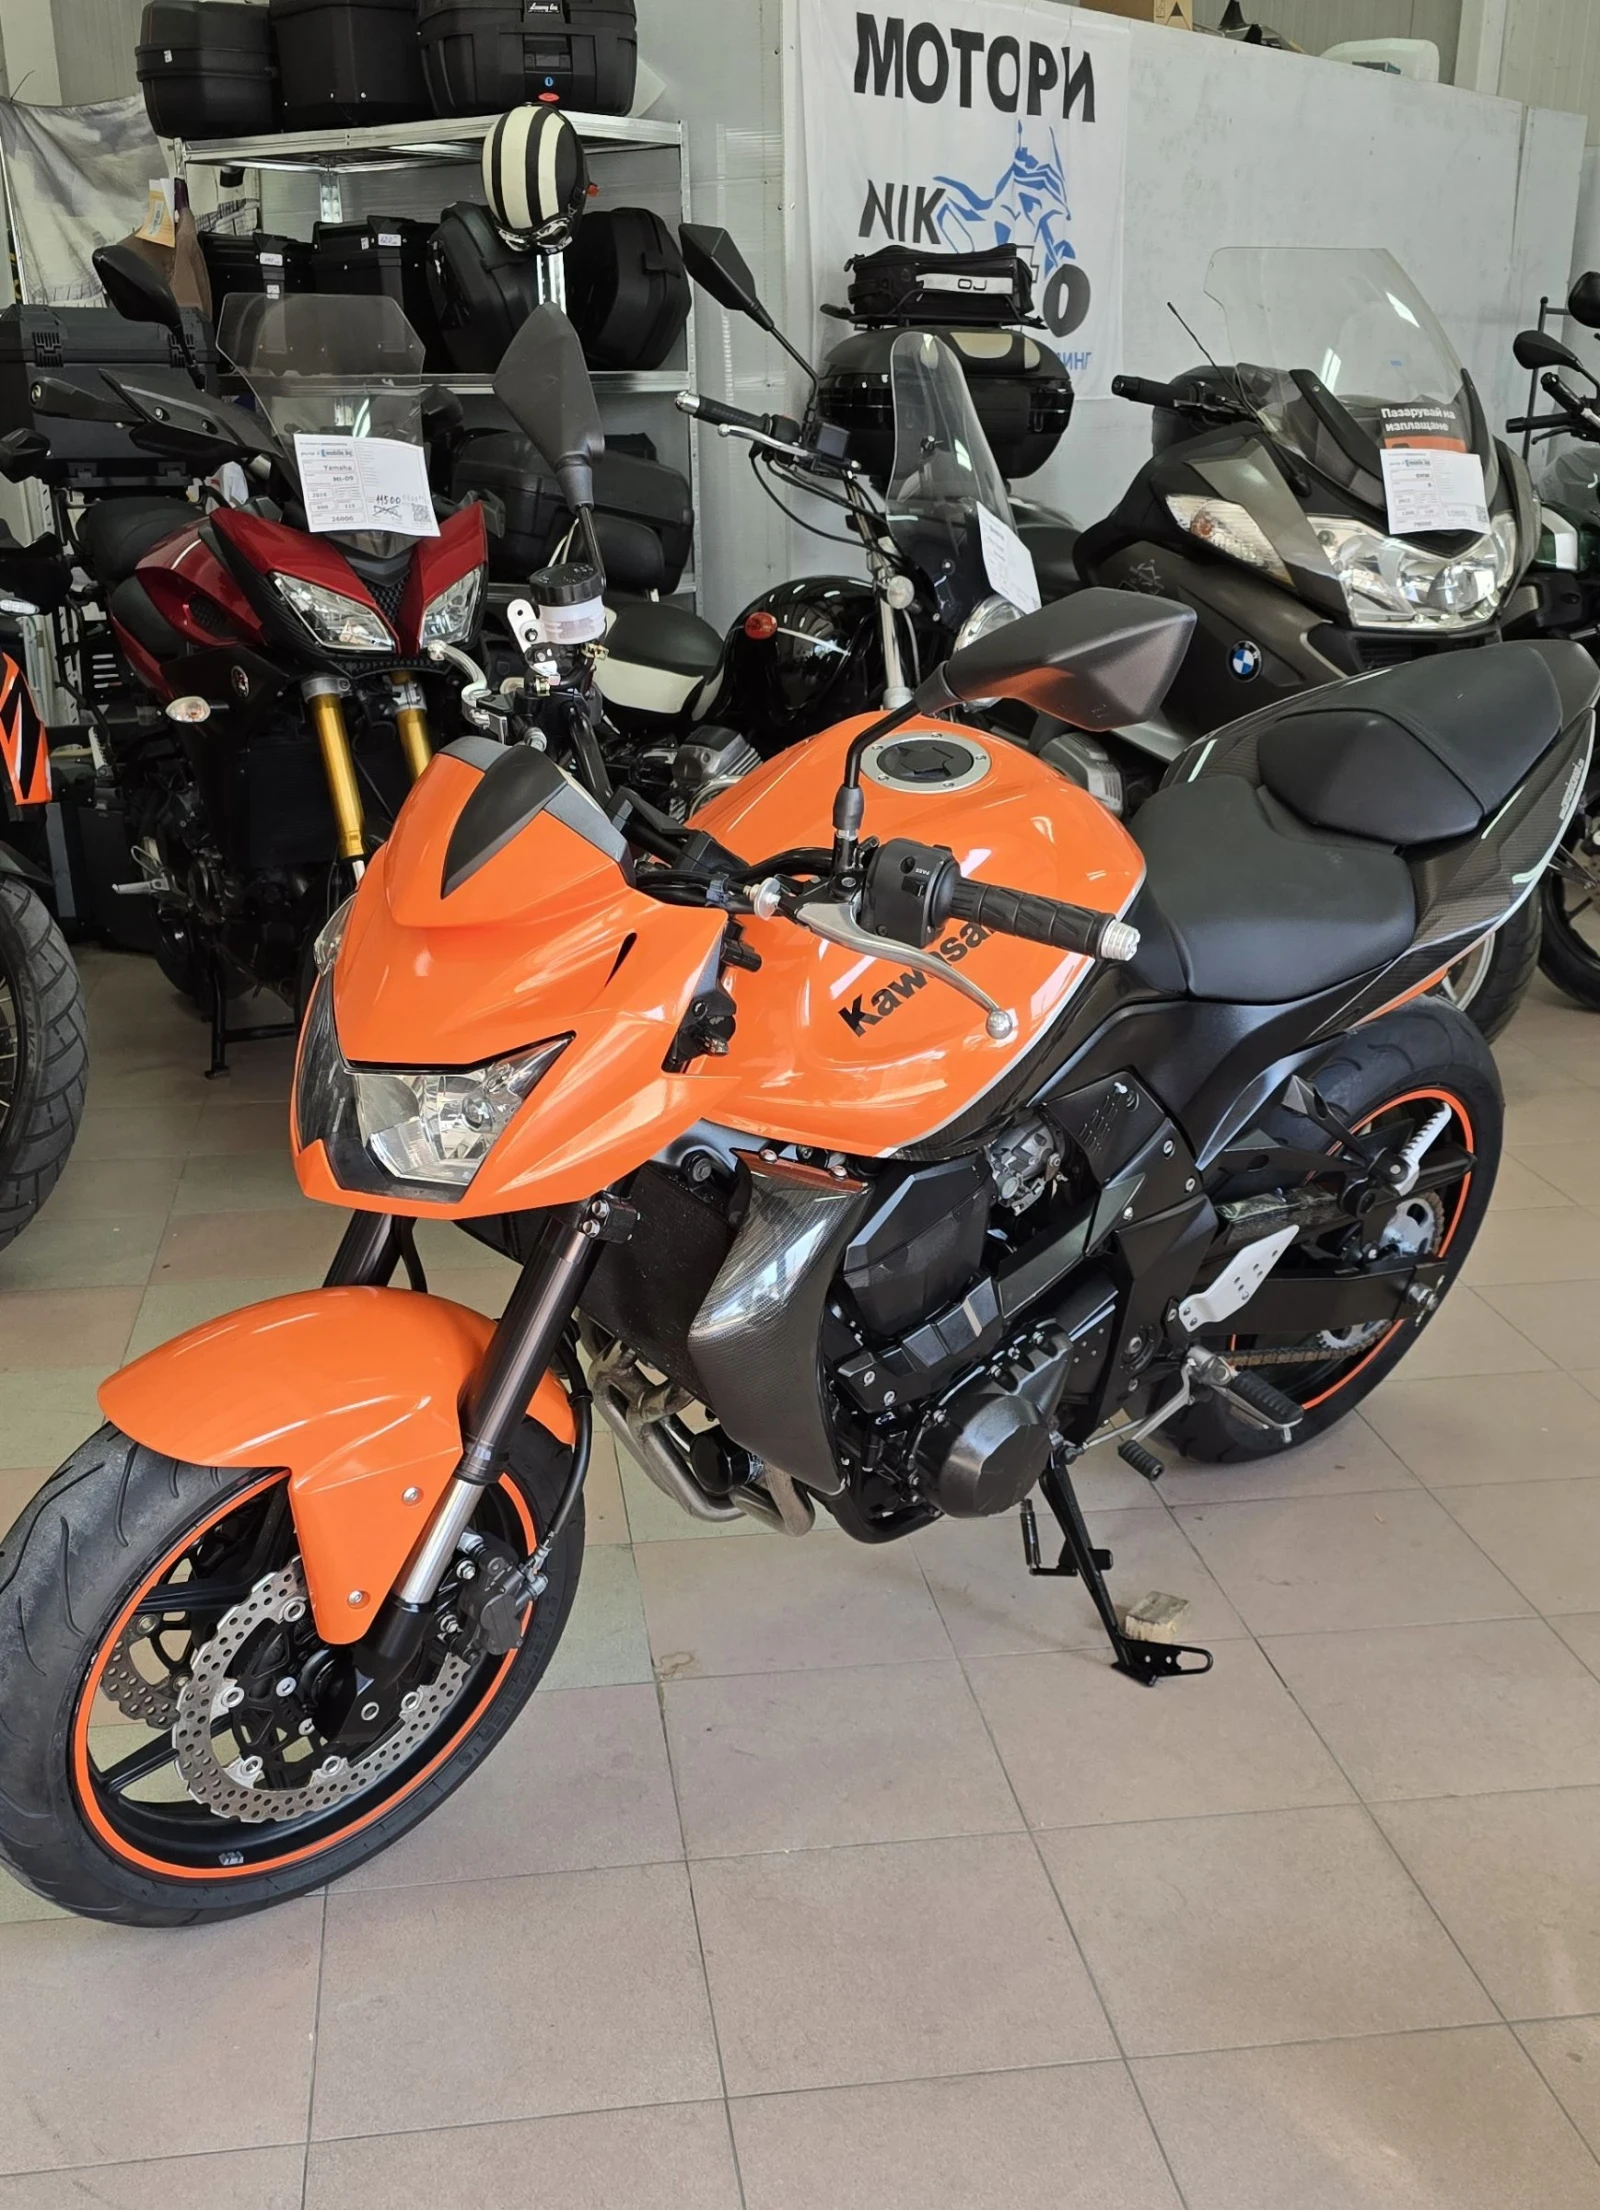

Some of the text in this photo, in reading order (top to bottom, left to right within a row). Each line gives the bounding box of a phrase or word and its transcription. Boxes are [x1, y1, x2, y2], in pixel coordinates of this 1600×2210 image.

[854, 12, 1096, 123] МОТОРИ
[858, 178, 947, 245] NIK
[957, 278, 988, 291] OJ
[1381, 408, 1456, 419] Пазарувай на
[1385, 422, 1449, 432] изплащане
[376, 494, 401, 505] 11500
[838, 922, 994, 1038] Kawsa
